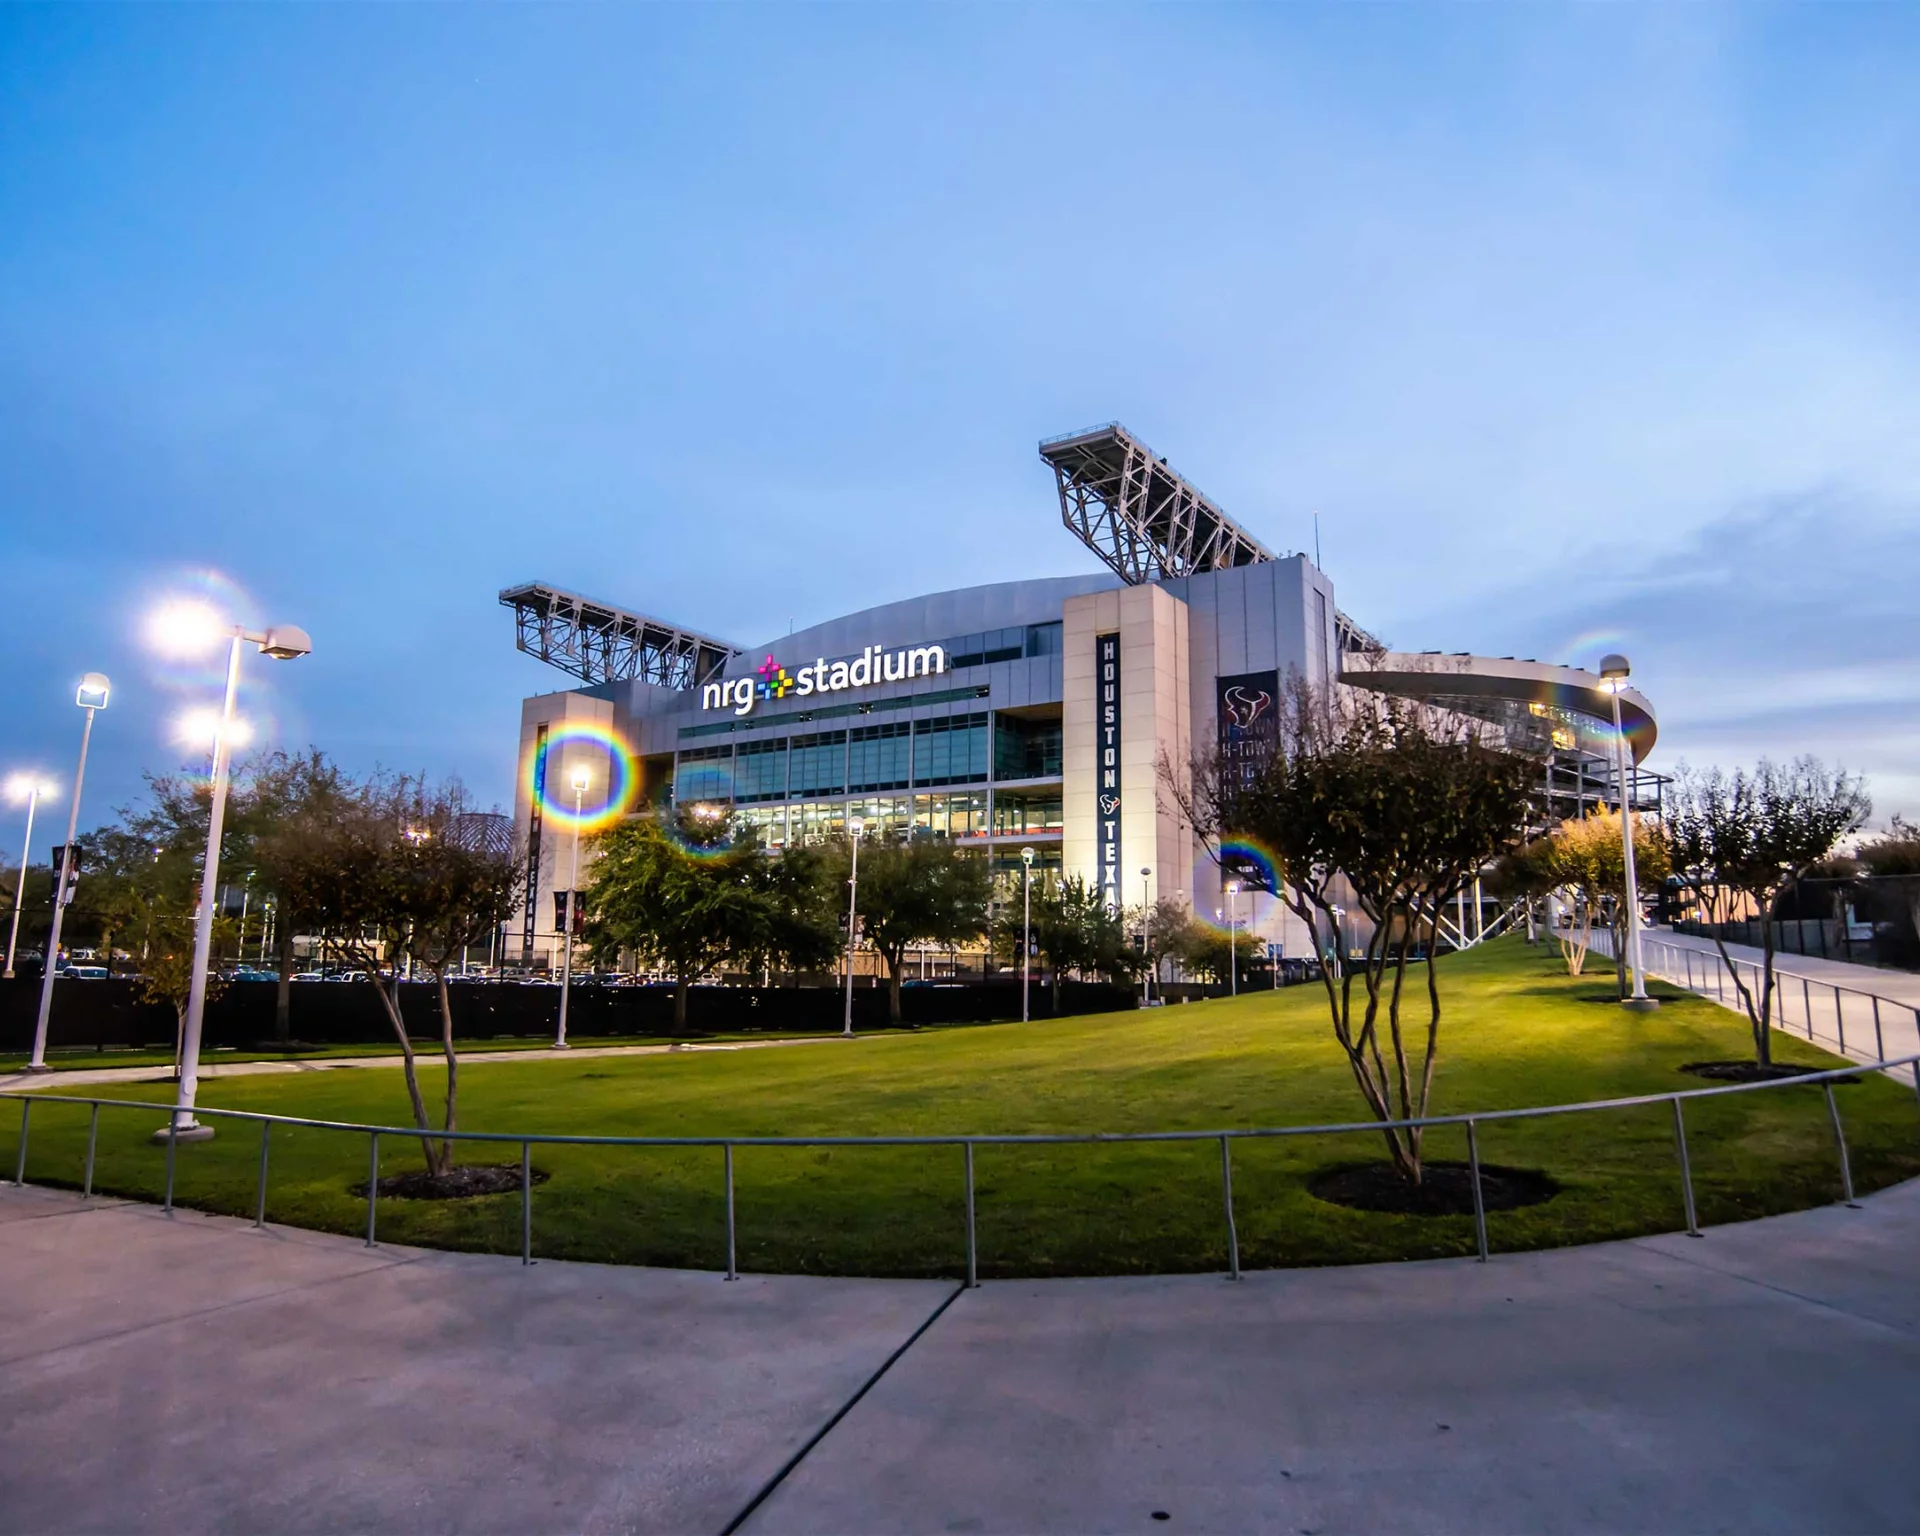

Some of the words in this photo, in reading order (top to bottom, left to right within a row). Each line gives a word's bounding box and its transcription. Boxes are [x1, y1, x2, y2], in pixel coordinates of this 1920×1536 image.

[703, 678, 754, 715] nrg
[795, 645, 945, 696] stadium
[1104, 642, 1116, 788] HOUSTON
[526, 856, 536, 946] TEXANS
[1104, 821, 1117, 922] TEXA
